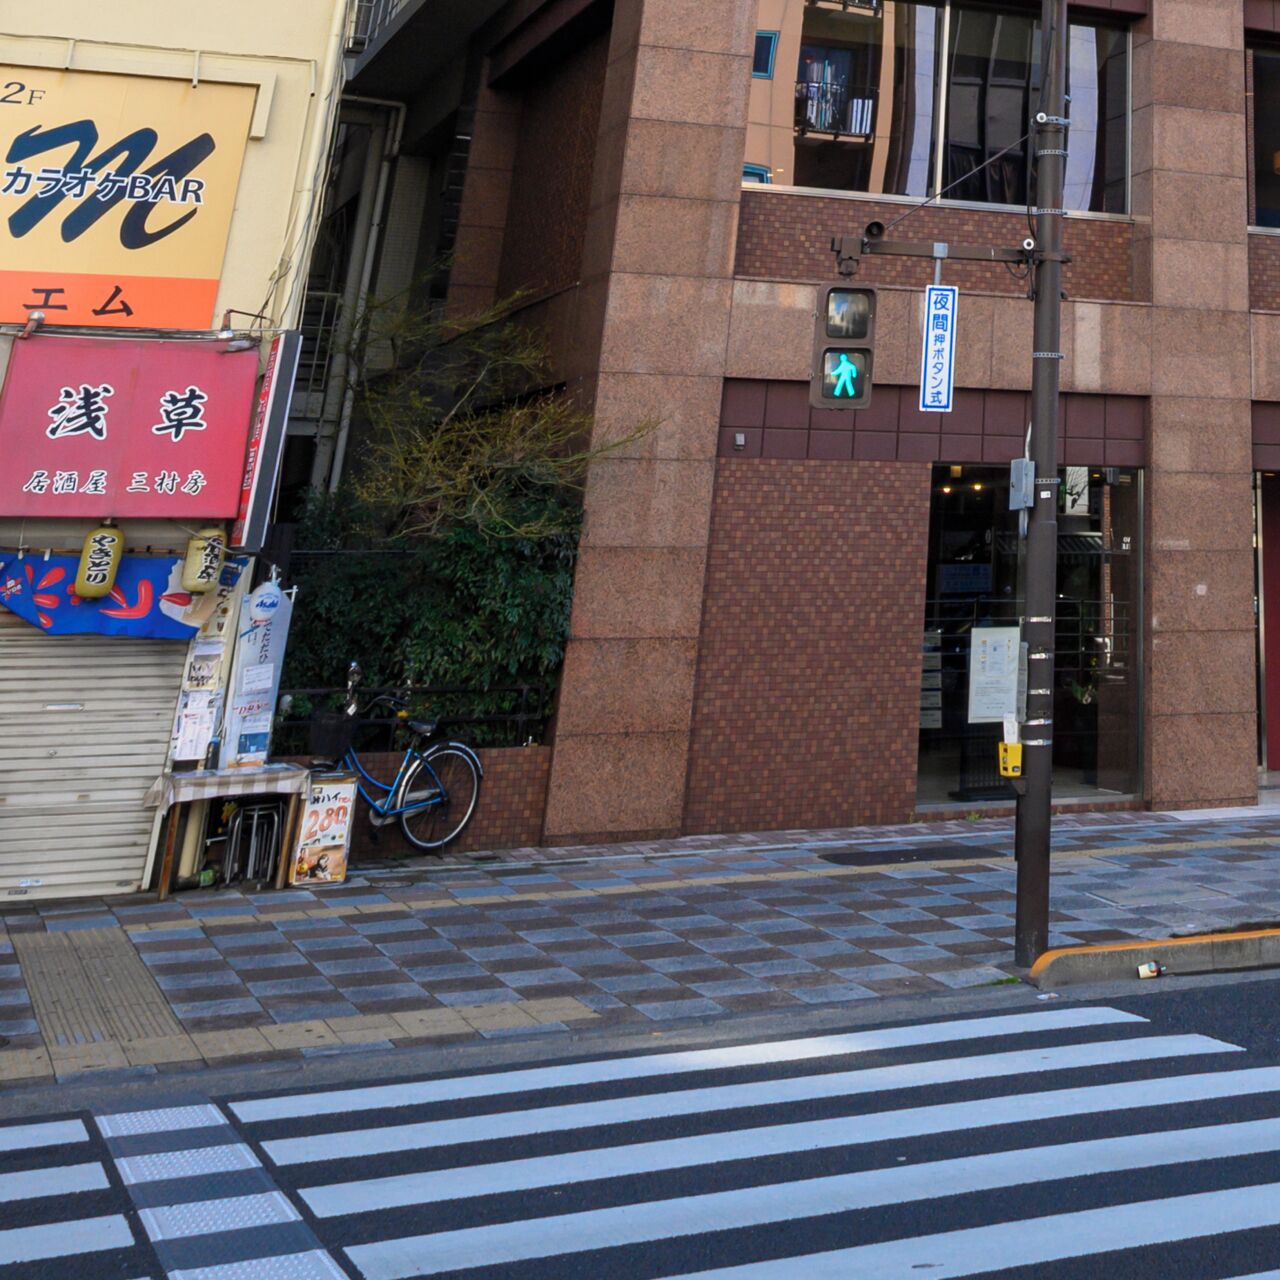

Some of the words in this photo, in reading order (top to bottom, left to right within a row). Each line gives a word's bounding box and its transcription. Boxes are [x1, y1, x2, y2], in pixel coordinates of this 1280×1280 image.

[0, 81, 46, 106] 2F
[1, 165, 206, 205] カラオケBAR
[22, 285, 134, 318] エム
[46, 383, 208, 442] 浅草
[23, 469, 108, 495] 居酒屋
[126, 469, 208, 495] 三村房
[86, 533, 118, 587] やきとり
[255, 599, 279, 609] Asahi
